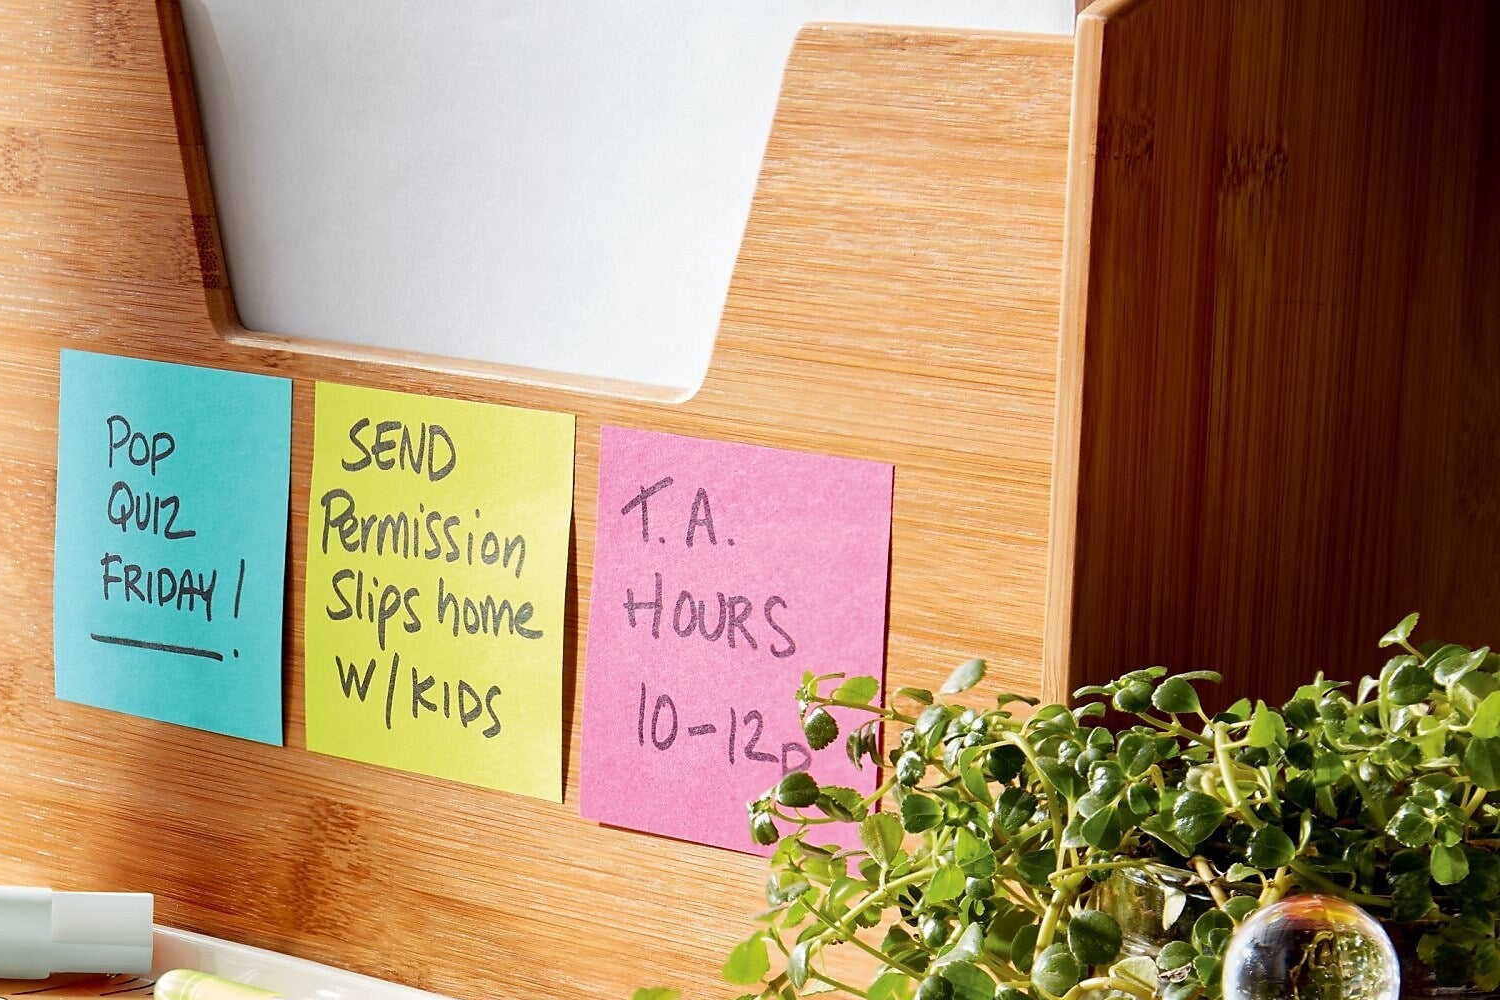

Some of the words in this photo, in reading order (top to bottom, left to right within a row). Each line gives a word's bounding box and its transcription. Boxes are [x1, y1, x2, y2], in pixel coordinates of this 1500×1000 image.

[106, 415, 175, 475] POP
[341, 417, 457, 482] SEND
[107, 481, 196, 540] QUIZ
[320, 488, 527, 579] Permission
[620, 476, 736, 548] T.A.
[326, 568, 422, 651] Slips
[436, 576, 544, 639] home
[622, 572, 797, 659] HOURS
